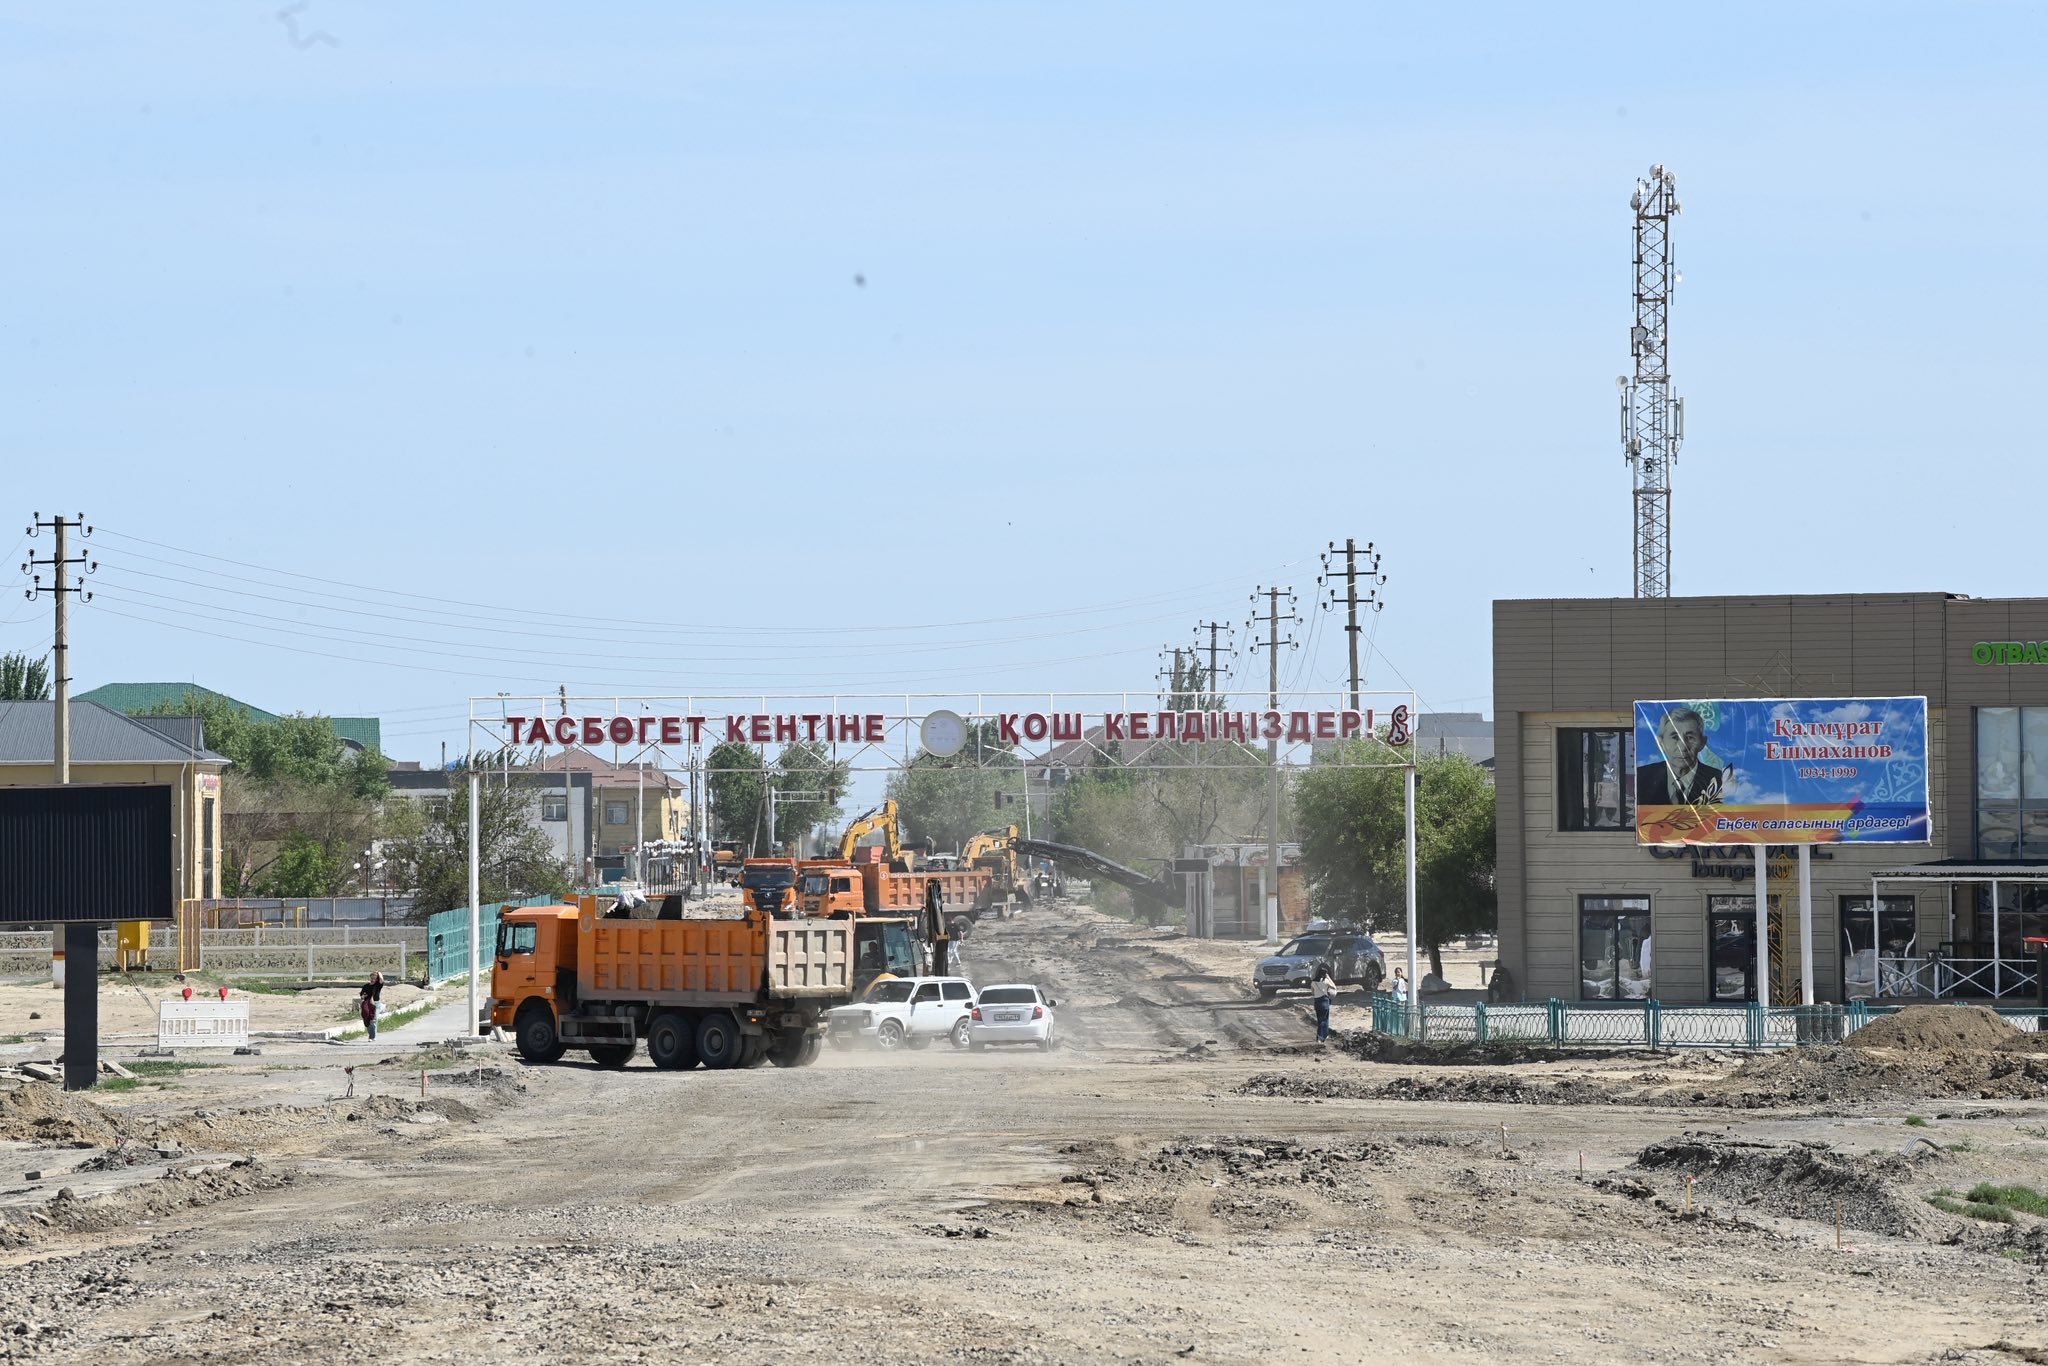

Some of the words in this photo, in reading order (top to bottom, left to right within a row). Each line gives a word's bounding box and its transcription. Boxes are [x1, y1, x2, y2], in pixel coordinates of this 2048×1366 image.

[506, 716, 706, 745] ТАСБӨГЕТ
[727, 714, 886, 742] КЕНТІНЕ
[1000, 713, 1082, 745] ҚОШ
[1104, 710, 1374, 743] КЕЛДІҢІЗДЕР!
[1774, 719, 1882, 741] Қалмұрат
[1765, 742, 1892, 759] Ешмаханов
[1800, 767, 1857, 778] 1934-1999
[1717, 818, 1758, 830] Еңбек
[1762, 818, 1844, 830] саласының
[1848, 816, 1910, 831] ардагері
